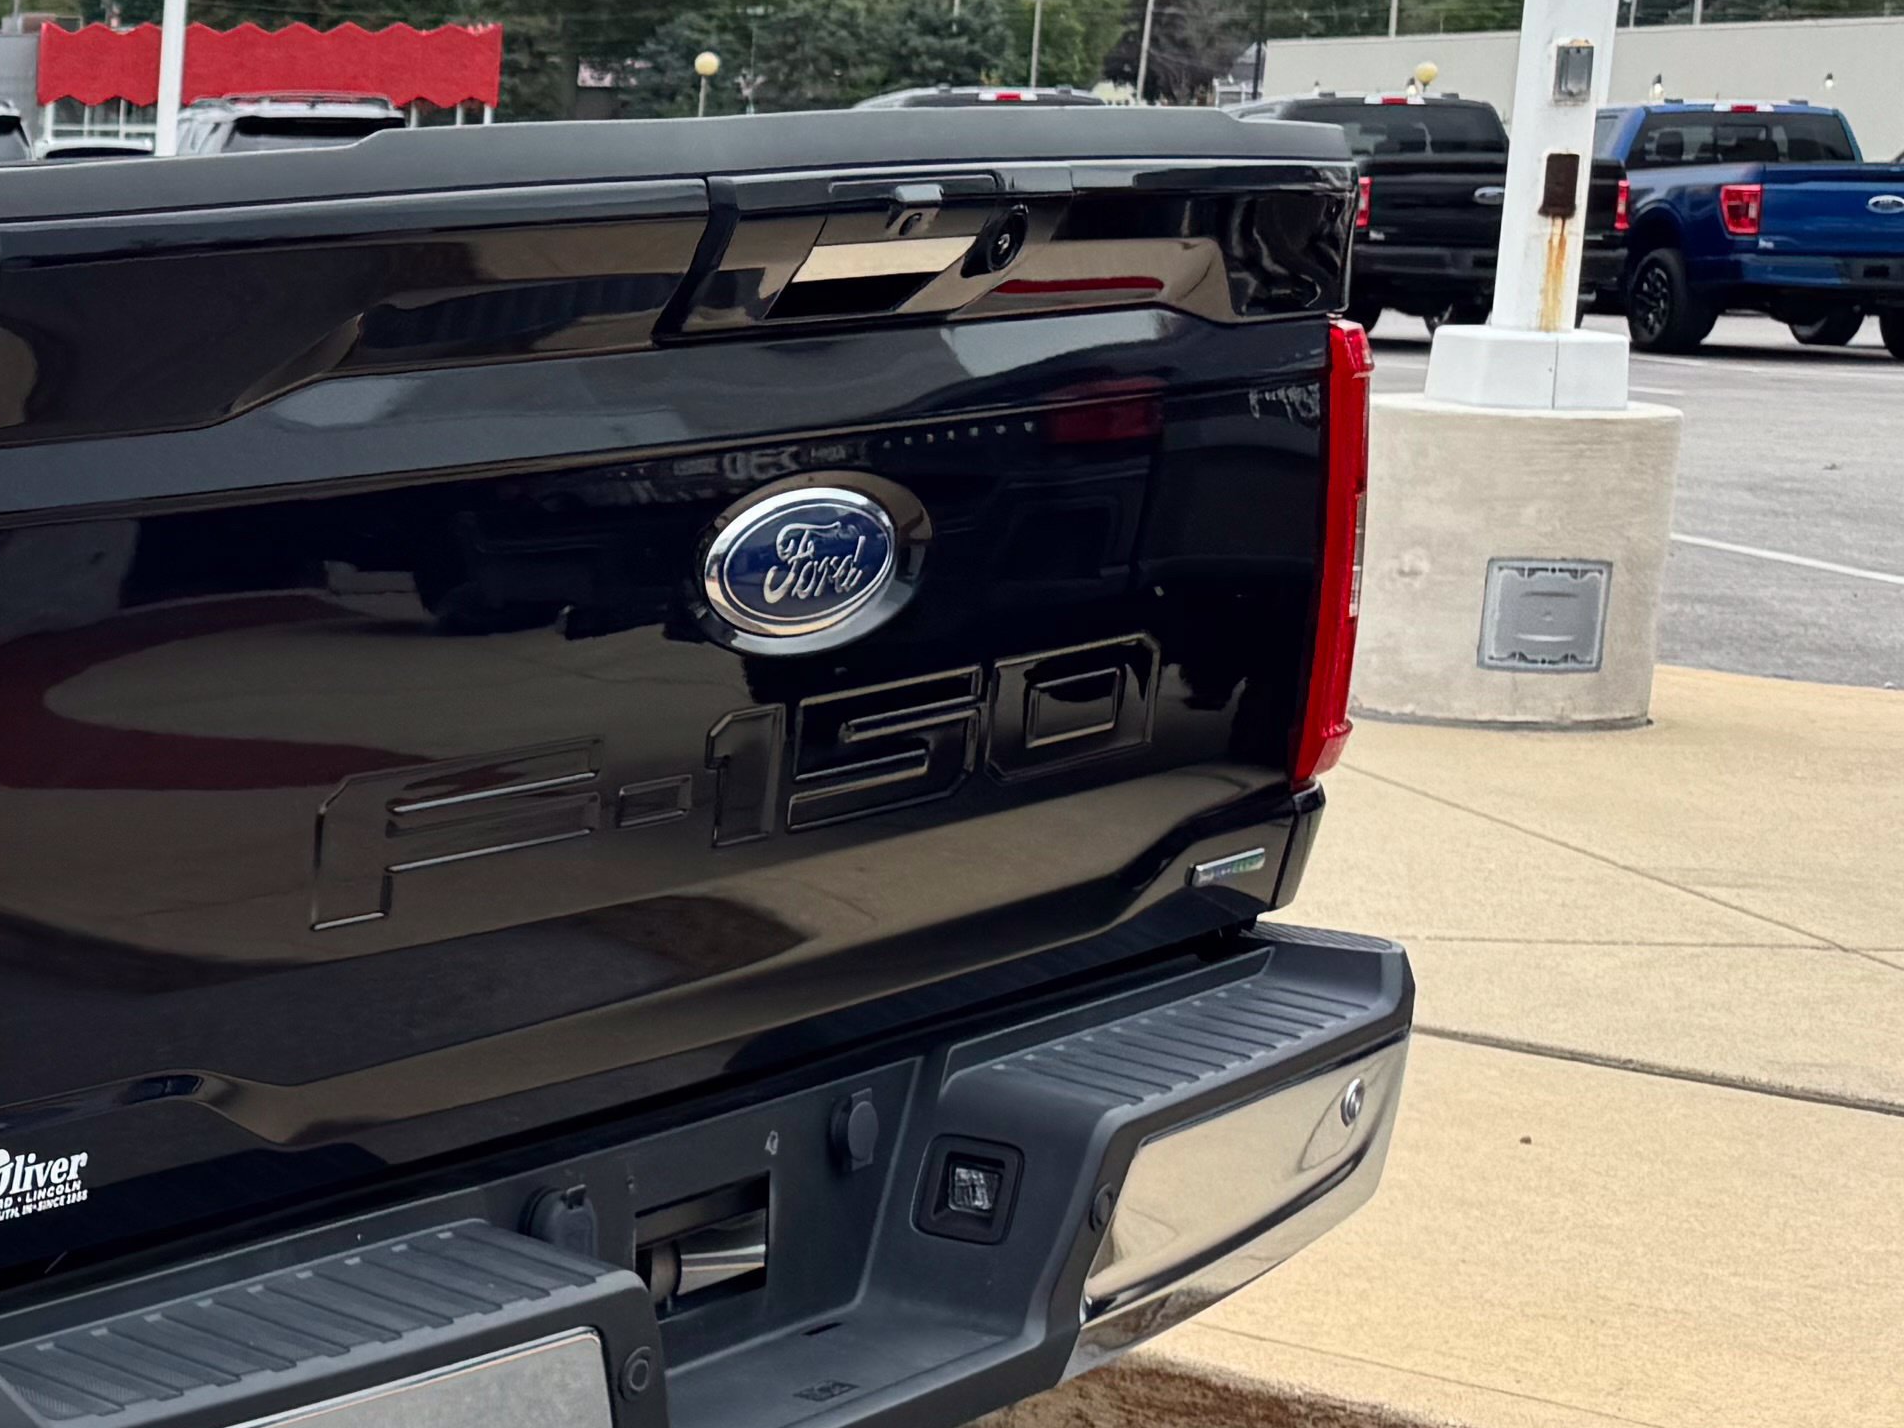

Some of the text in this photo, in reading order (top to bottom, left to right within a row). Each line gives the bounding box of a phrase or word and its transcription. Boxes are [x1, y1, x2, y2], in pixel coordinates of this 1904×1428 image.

[762, 521, 867, 605] Ford
[310, 630, 1161, 932] F-150
[25, 1179, 83, 1204] LINCOLN
